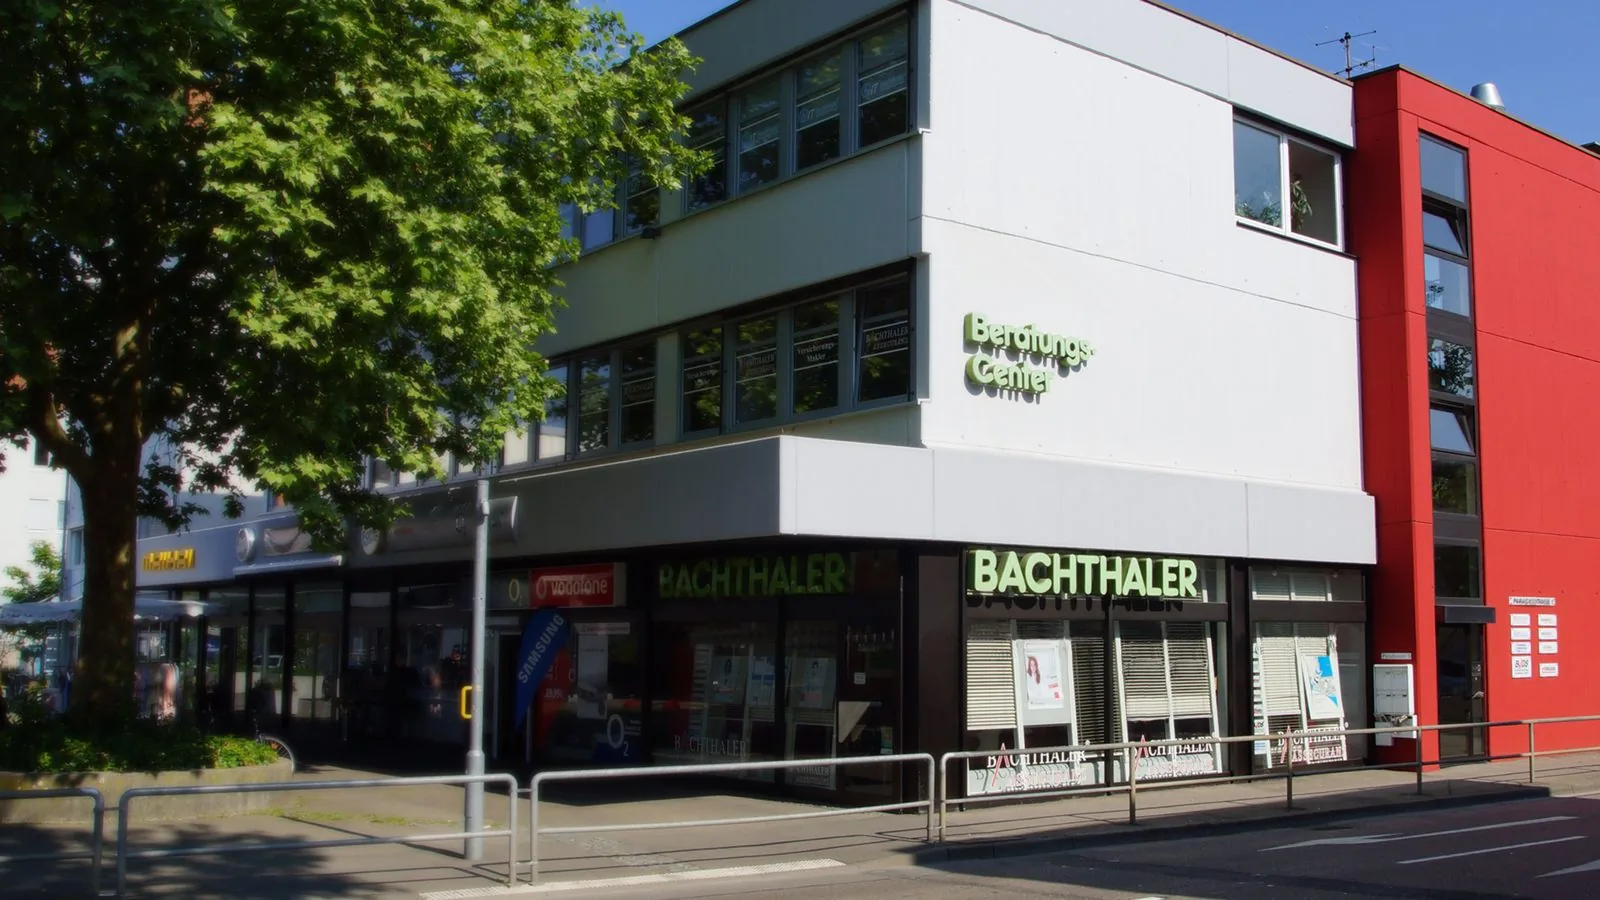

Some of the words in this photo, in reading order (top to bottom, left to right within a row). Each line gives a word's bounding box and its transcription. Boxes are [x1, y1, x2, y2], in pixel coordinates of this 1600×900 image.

[965, 354, 1053, 394] Center
[551, 574, 608, 596] vodafone
[657, 552, 846, 599] BACHTHALER
[970, 549, 1198, 597] BACHTHALER
[518, 614, 565, 685] SAMSUNG
